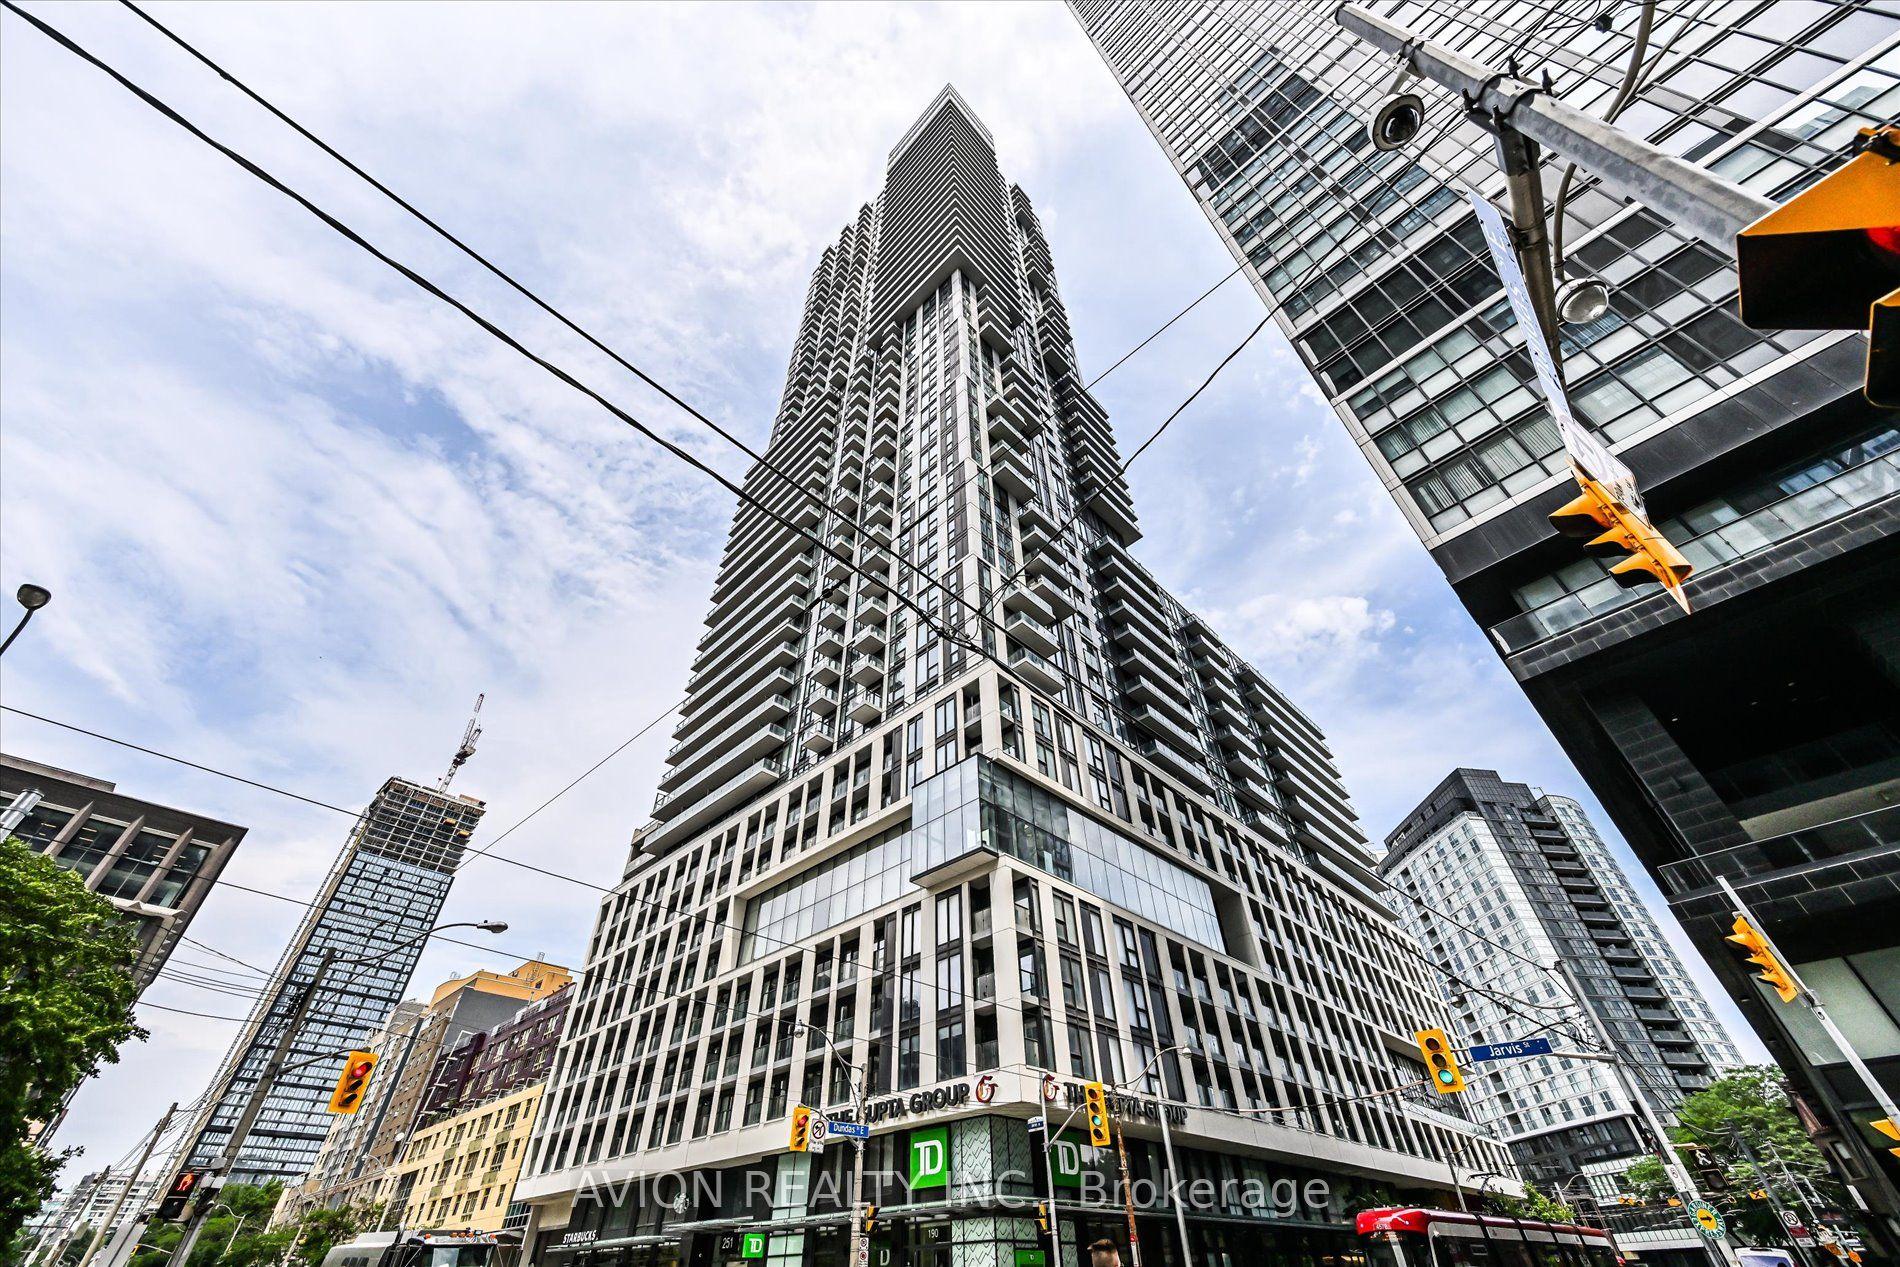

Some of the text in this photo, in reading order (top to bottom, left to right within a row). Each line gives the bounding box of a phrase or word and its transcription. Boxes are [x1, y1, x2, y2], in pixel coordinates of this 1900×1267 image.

[1490, 1043, 1522, 1057] Jarvis
[910, 1083, 970, 1114] GROUP
[1063, 1082, 1086, 1106] TH
[834, 1123, 856, 1134] Dundas
[913, 1139, 943, 1176] TD
[1053, 1140, 1079, 1175] TD
[563, 1230, 597, 1244] STARBUCKS
[928, 1228, 939, 1239] 190
[721, 1237, 733, 1249] 251
[749, 1238, 762, 1253] TD
